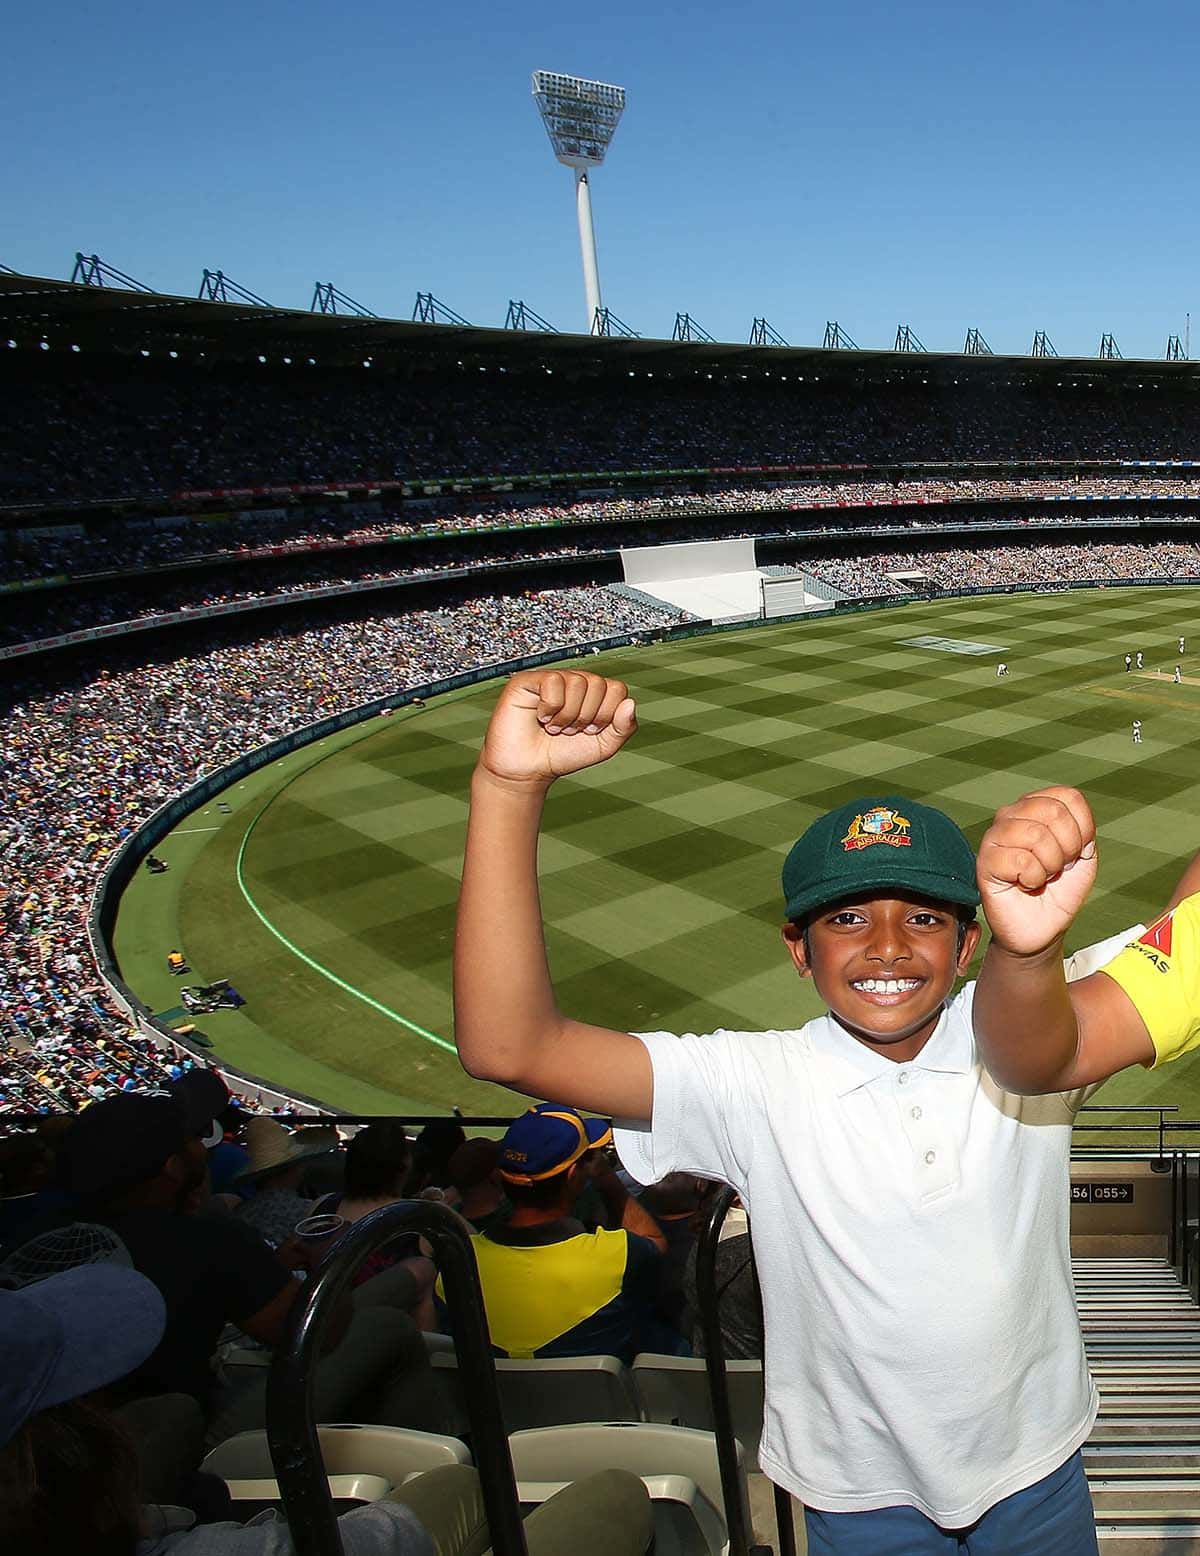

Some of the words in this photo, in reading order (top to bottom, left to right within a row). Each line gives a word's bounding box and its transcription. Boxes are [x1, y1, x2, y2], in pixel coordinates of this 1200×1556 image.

[856, 834, 900, 847] AUSTRALIA
[1070, 1187, 1088, 1198] 56
[1094, 1187, 1119, 1198] Q55
